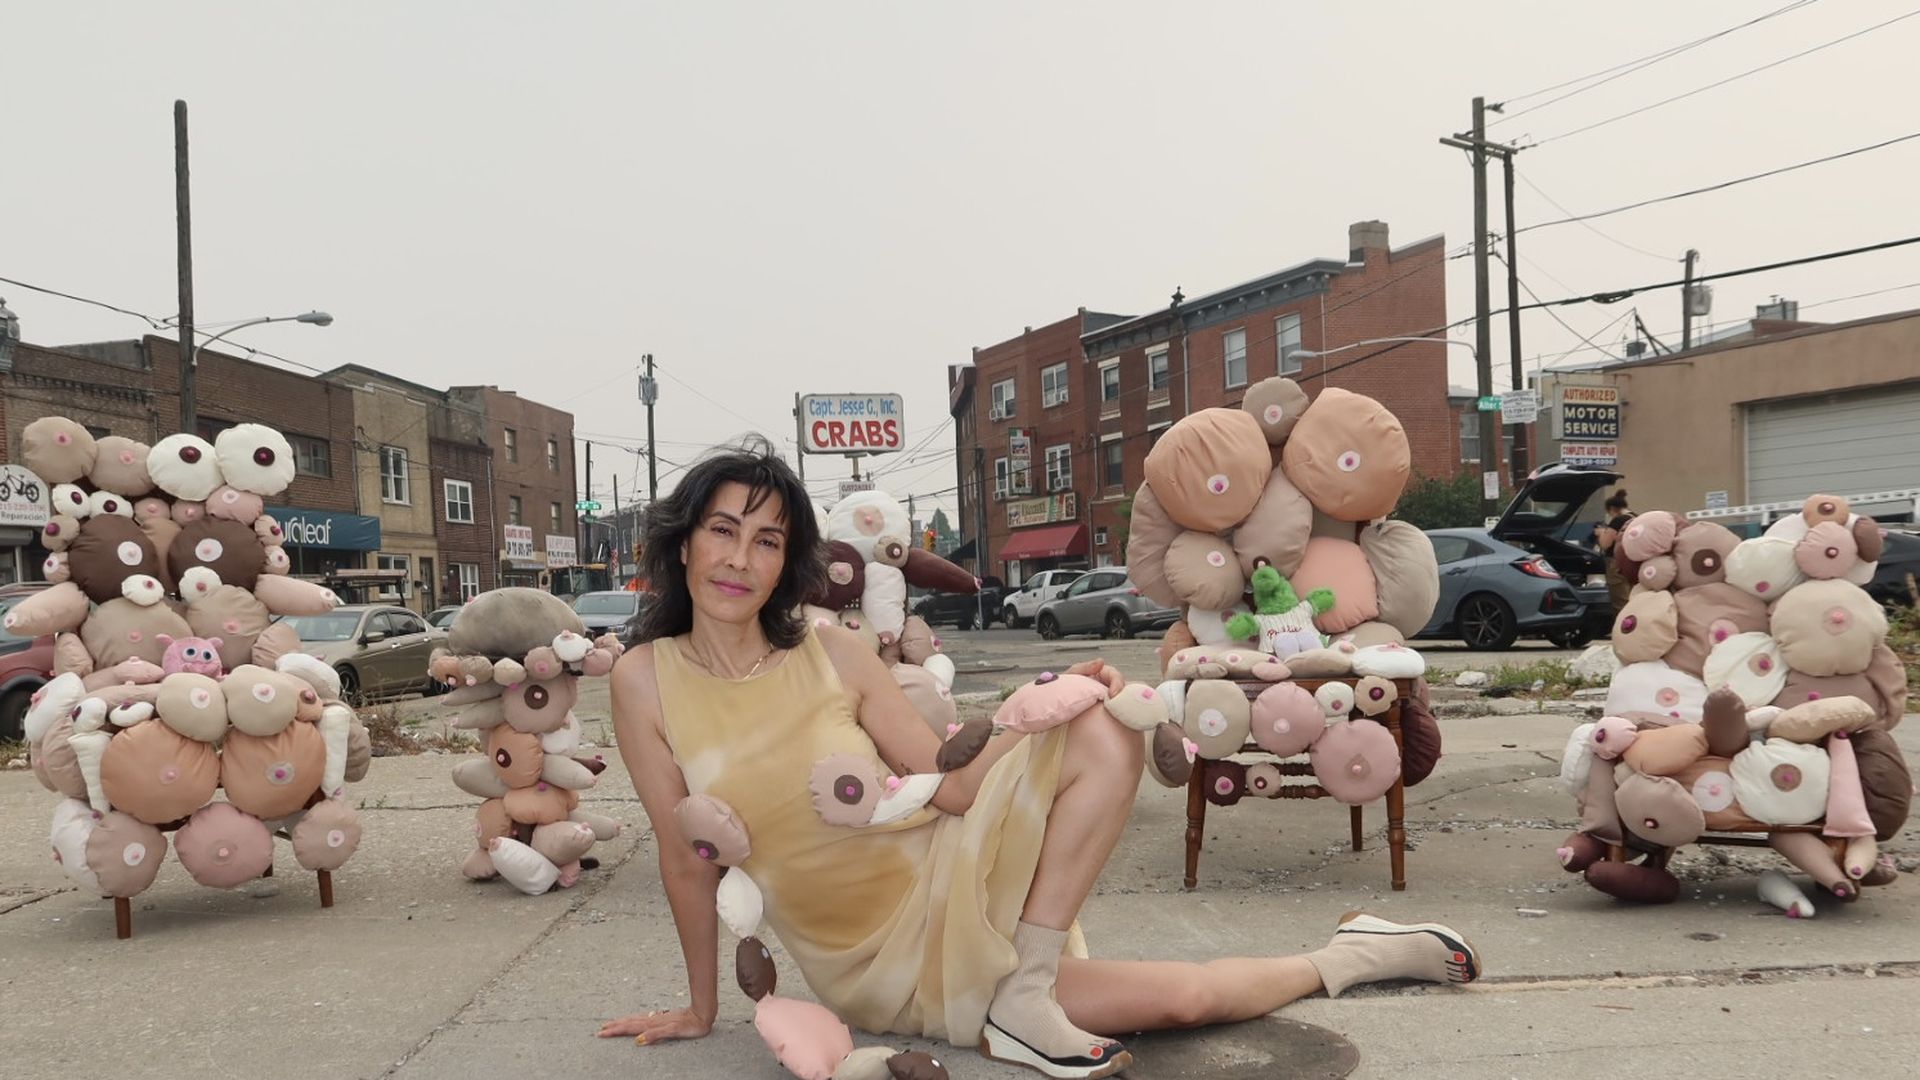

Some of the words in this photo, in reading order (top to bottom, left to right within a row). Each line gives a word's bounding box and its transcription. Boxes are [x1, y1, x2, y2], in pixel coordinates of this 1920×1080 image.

[1564, 388, 1616, 402] AUTHORIZED
[810, 399, 836, 417] Capt.
[839, 399, 864, 415] Jesse
[881, 399, 897, 414] Inc.
[1478, 400, 1497, 411] Alter
[1564, 406, 1616, 420] MOTOR
[811, 419, 899, 448] CRABS
[1564, 421, 1617, 435] SERVICE
[277, 516, 332, 545] uraleaf
